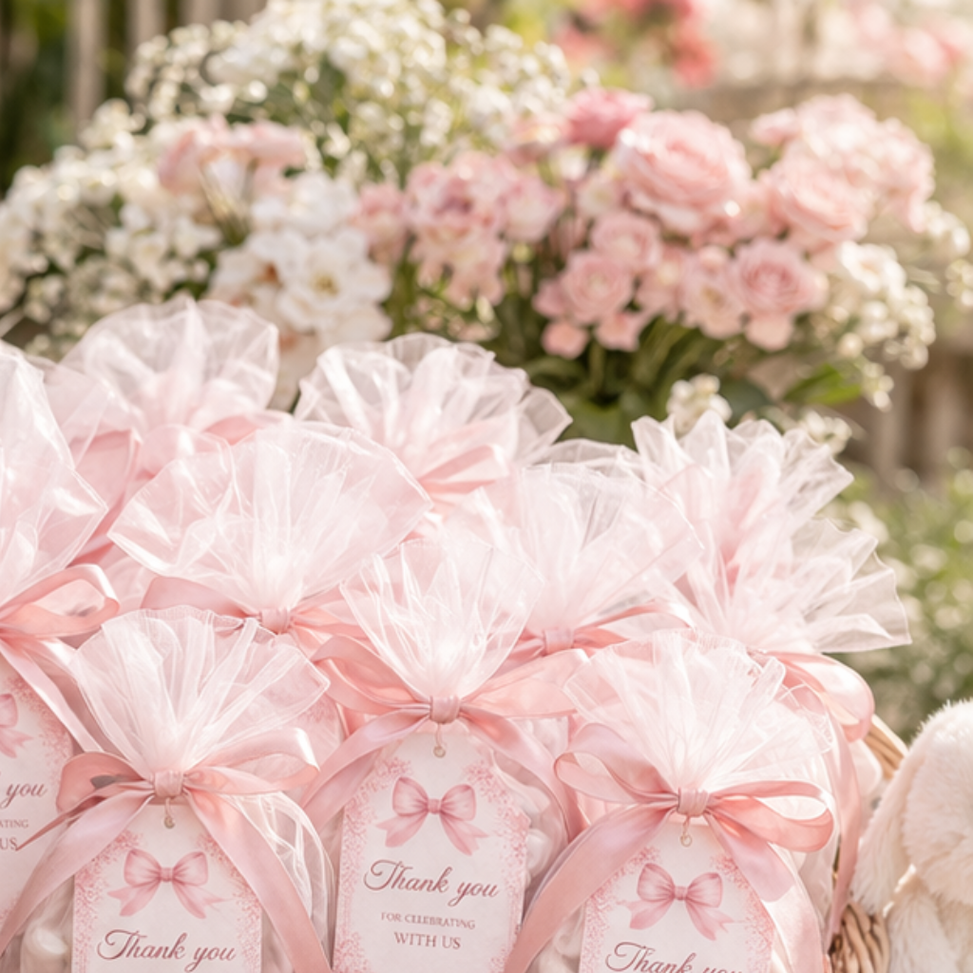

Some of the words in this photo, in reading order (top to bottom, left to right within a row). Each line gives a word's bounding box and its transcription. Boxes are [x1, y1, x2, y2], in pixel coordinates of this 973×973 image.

[363, 859, 453, 894] Thank
[447, 881, 500, 907] you
[381, 912, 402, 923] FOR
[96, 929, 188, 960] Thank
[184, 946, 237, 973] you
[394, 932, 437, 948] WITH
[442, 936, 462, 950] US
